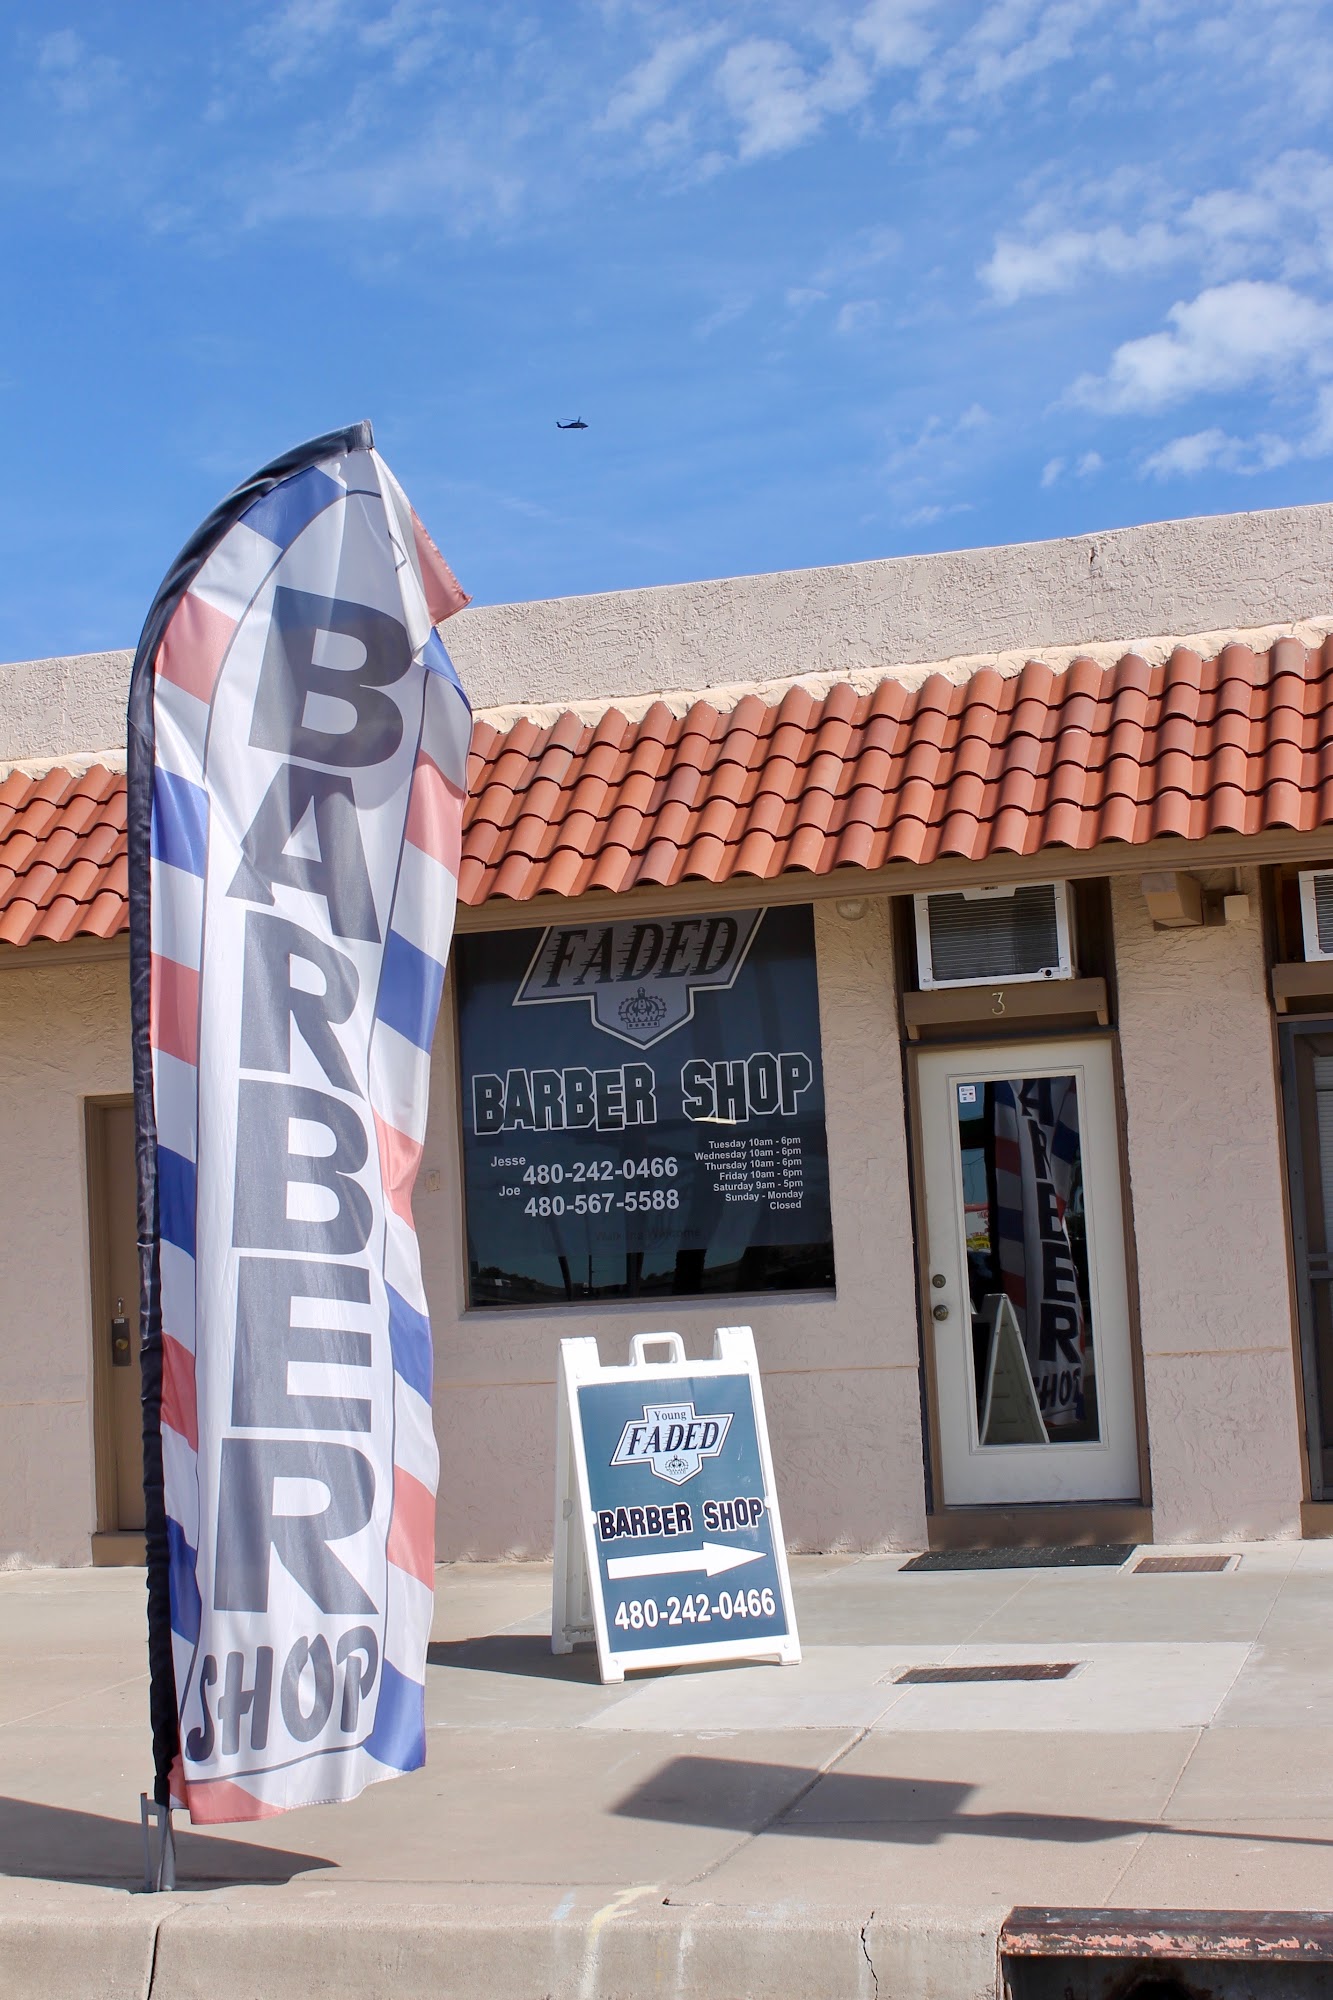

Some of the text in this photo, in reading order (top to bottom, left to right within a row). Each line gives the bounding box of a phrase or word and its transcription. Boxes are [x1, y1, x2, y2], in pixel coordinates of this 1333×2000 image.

[542, 917, 738, 988] FADED
[990, 991, 1006, 1016] 3
[213, 585, 412, 1615] BARBER
[472, 1052, 813, 1135] BARBER SHOP
[694, 1150, 747, 1160] Wednesday
[749, 1149, 774, 1157] 10am
[781, 1147, 801, 1157] 6pm
[708, 1139, 746, 1149] Tuesday
[749, 1138, 773, 1147] 10am
[781, 1136, 801, 1146] 6pm
[490, 1156, 678, 1185] Jesse 480-242-0466
[705, 1161, 747, 1171] Thursday
[750, 1159, 774, 1168] 10am
[782, 1158, 802, 1168] 6pm
[719, 1172, 748, 1181] Friday
[750, 1170, 775, 1179] 10am
[782, 1168, 803, 1178] 6pm
[713, 1182, 753, 1192] Saturday
[755, 1181, 775, 1189] 9am
[783, 1179, 803, 1189] 5pm
[725, 1192, 759, 1202] Sunday
[767, 1190, 804, 1199] Monday
[499, 1185, 680, 1217] Joe 480-567-5588
[769, 1200, 802, 1210] Closed
[1018, 1080, 1081, 1364] ARBER
[654, 1410, 687, 1421] Young
[625, 1421, 720, 1456] FADED
[598, 1497, 764, 1542] BARBER SHOP
[614, 1587, 776, 1631] 480-242-0466
[185, 1625, 379, 1762] SHOP
